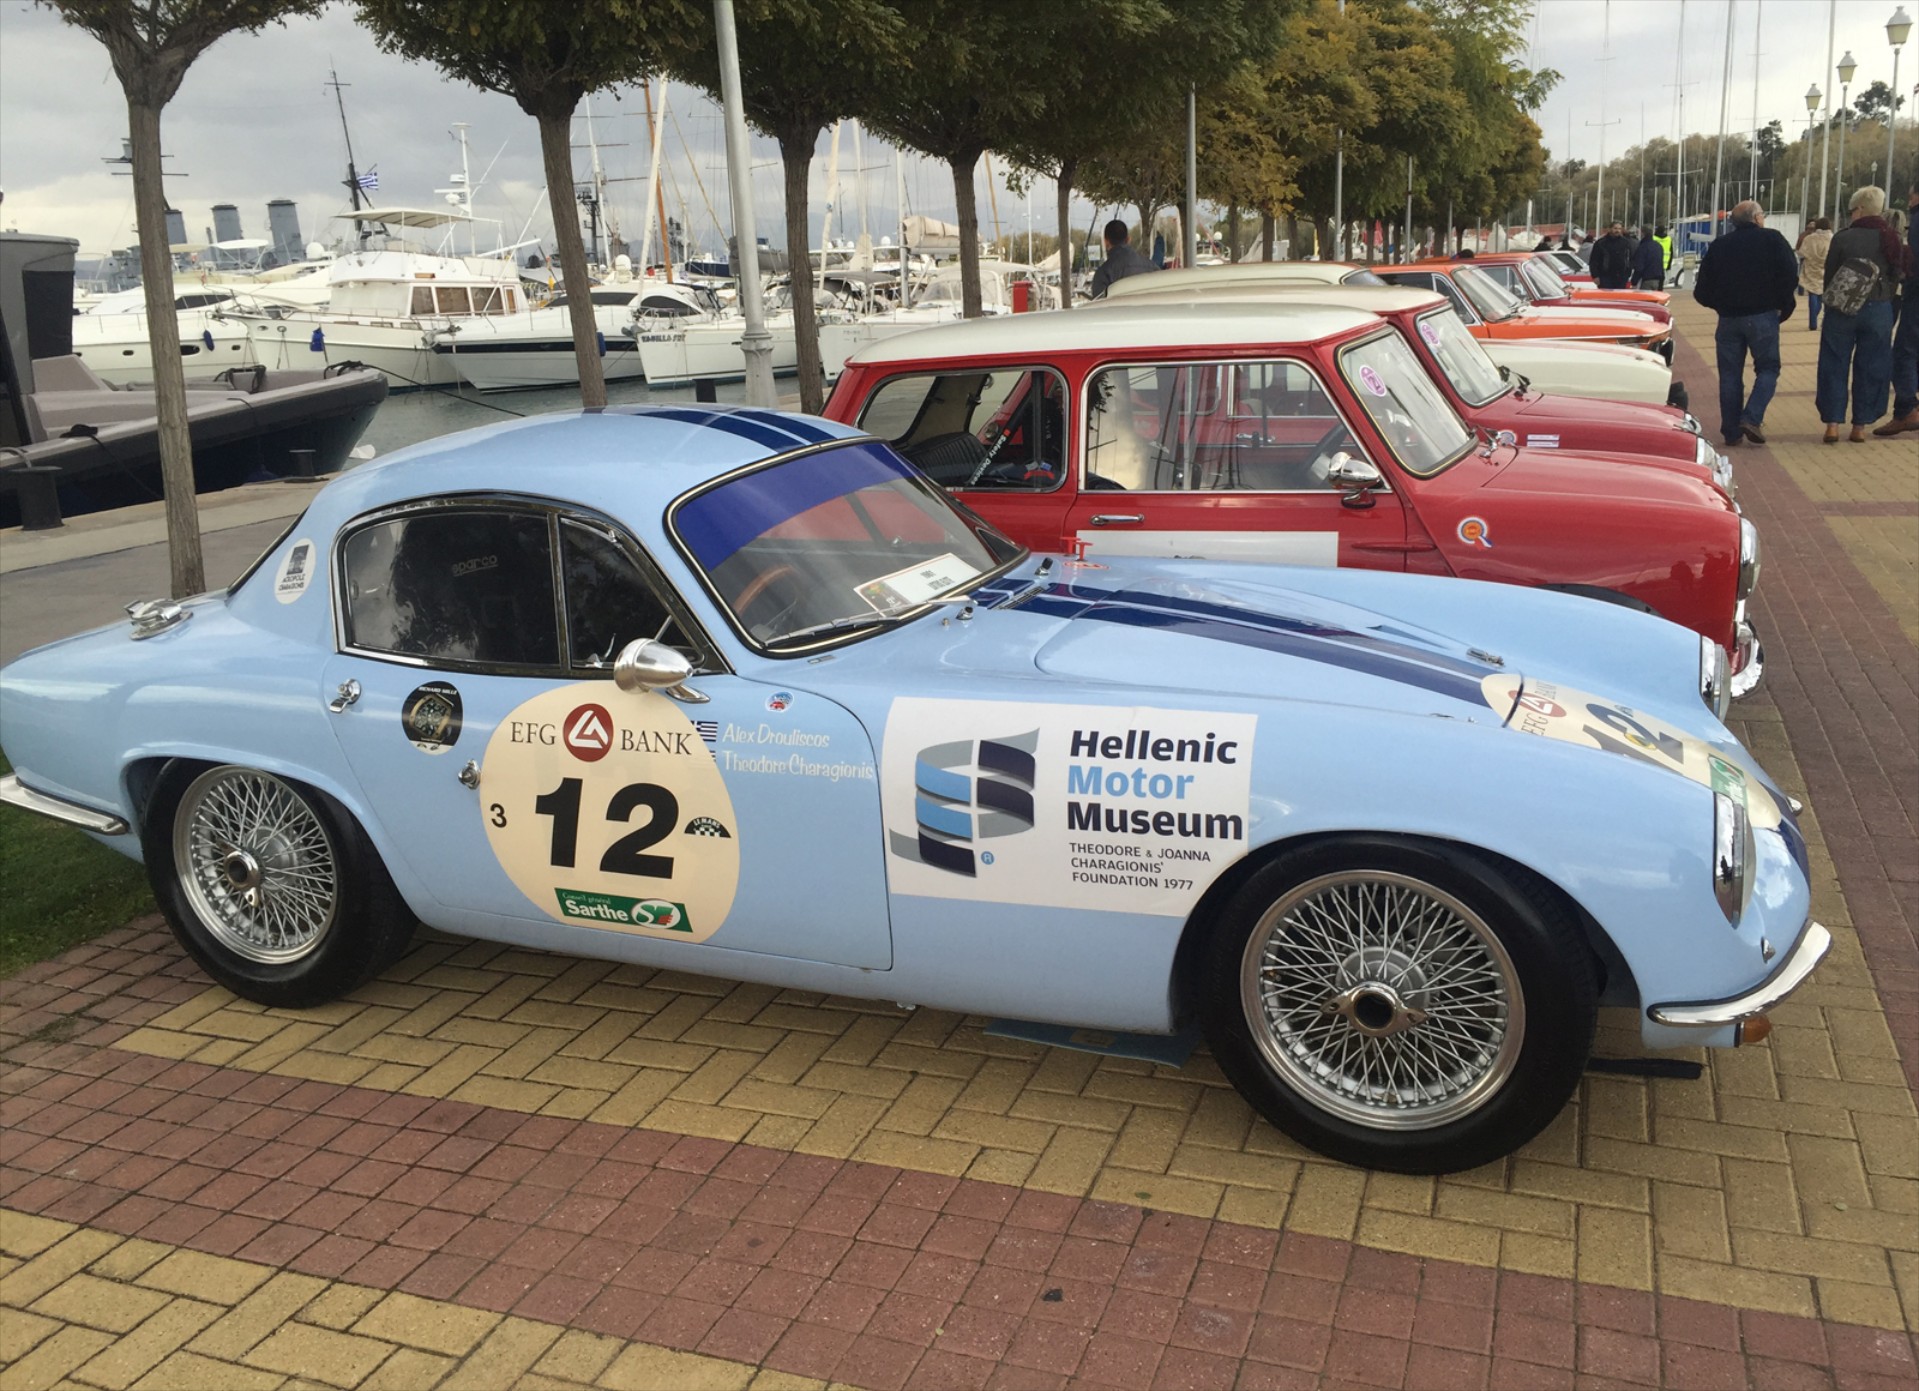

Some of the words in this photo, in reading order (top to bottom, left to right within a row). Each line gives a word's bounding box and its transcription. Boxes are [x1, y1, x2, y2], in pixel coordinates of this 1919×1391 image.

[988, 434, 1007, 458] Safety
[451, 554, 498, 577] sparco
[510, 721, 556, 745] EFG
[621, 729, 692, 755] BANK
[722, 723, 754, 744] Alex
[757, 723, 830, 748] Drouliscos
[1070, 730, 1238, 764] Hellenic
[722, 750, 786, 773] Theodore
[788, 753, 873, 783] Charagionis
[1067, 765, 1195, 800] Motor
[490, 803, 508, 829] 3
[535, 777, 680, 880] 12
[1067, 802, 1243, 840] Museum
[1069, 842, 1142, 857] THEODORE
[1157, 849, 1211, 862] JOANNA
[1070, 857, 1165, 874] CHARAGIONIS'
[1072, 872, 1159, 889] FOUNDATION
[1163, 878, 1194, 892] 1977
[565, 899, 629, 922] Sarthe
